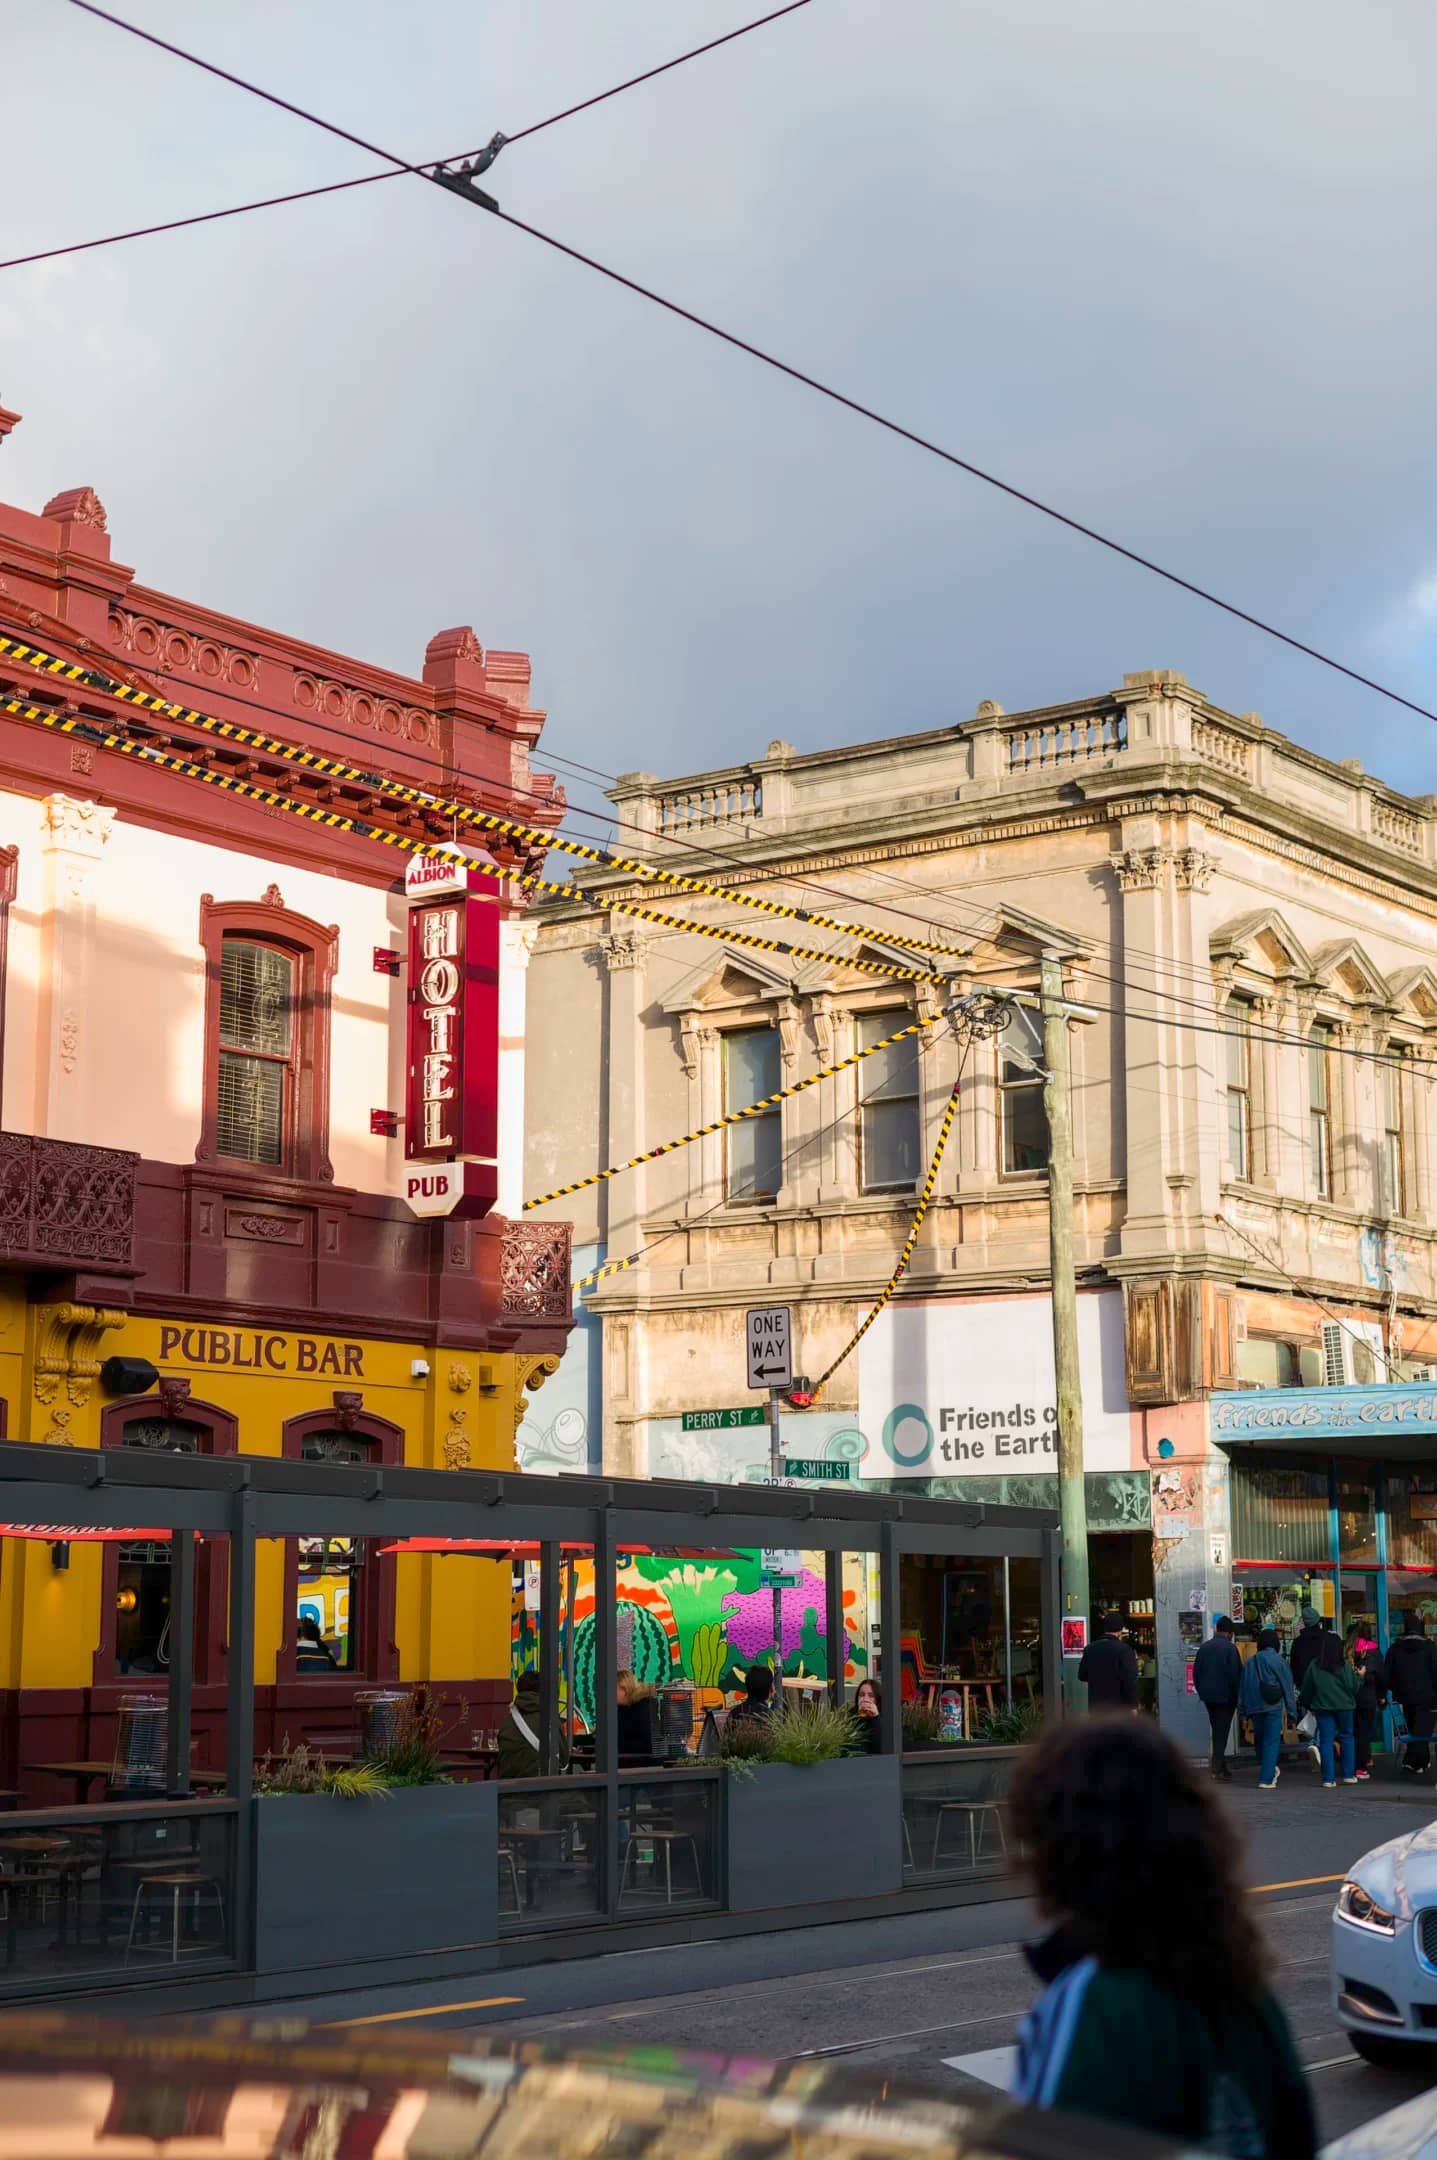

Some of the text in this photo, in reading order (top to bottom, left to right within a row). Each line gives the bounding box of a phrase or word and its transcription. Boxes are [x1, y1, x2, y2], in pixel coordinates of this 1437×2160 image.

[408, 865, 455, 886] ALBION
[421, 909, 458, 1148] HOTEL
[407, 1175, 449, 1198] PUB
[753, 1315, 783, 1334] ONE
[159, 1326, 364, 1377] PUBLIC BAR
[751, 1339, 785, 1358] WAY
[686, 1410, 743, 1430] PERRY ST
[939, 1404, 1036, 1432] Friends
[1215, 1402, 1324, 1429] friends
[1328, 1412, 1358, 1427] the
[940, 1437, 985, 1462] the
[802, 1462, 848, 1479] SMITH ST
